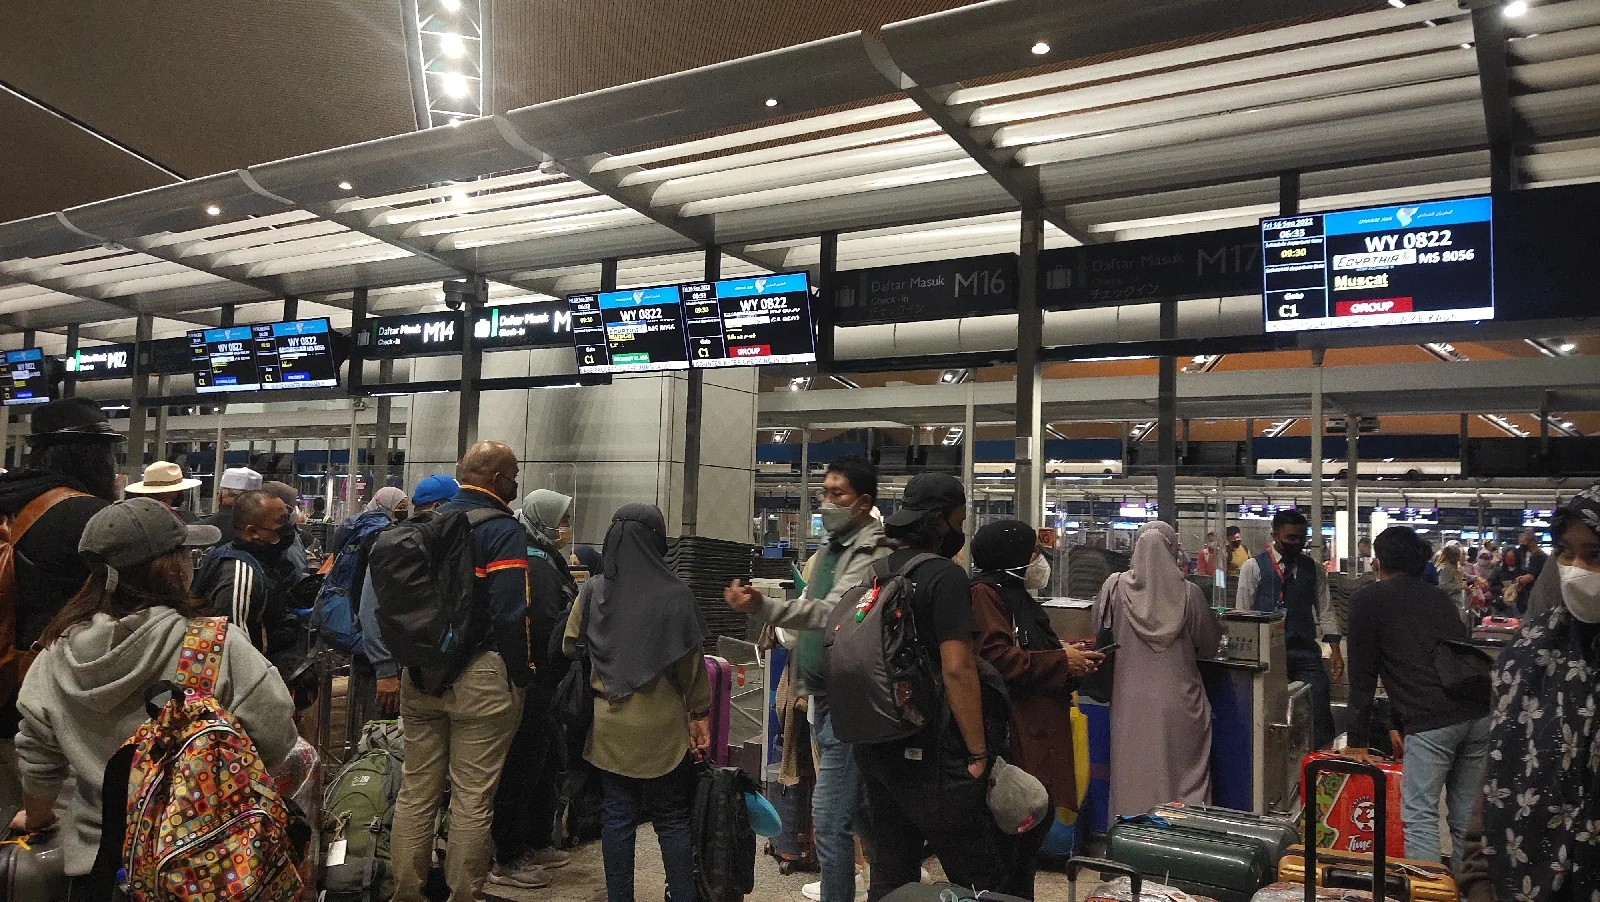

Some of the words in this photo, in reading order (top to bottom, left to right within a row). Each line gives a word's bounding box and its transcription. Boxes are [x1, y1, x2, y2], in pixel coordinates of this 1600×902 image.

[1364, 234, 1399, 252] WY
[1403, 230, 1453, 249] 0822
[1091, 257, 1134, 272] Daftar
[1141, 251, 1185, 268] Masuk
[1197, 242, 1260, 277] M17
[1280, 248, 1306, 258] 09:30
[1337, 254, 1400, 268] EGYPTAIR
[1419, 253, 1440, 264] MS
[1442, 249, 1475, 262] 8056
[872, 279, 905, 292] Daftar
[910, 274, 945, 289] Masuk
[953, 269, 1006, 298] M16
[1334, 272, 1388, 289] Muscat
[740, 299, 758, 312] WY
[760, 297, 787, 310] 0822
[1279, 303, 1299, 317] C1
[1350, 301, 1395, 313] GROUP
[620, 309, 637, 321] WY
[639, 307, 663, 319] 0822
[378, 326, 399, 336] Daftar
[424, 320, 455, 343] M14
[698, 347, 709, 358] C1
[737, 347, 761, 355] GROUP
[1347, 834, 1373, 852] Time
